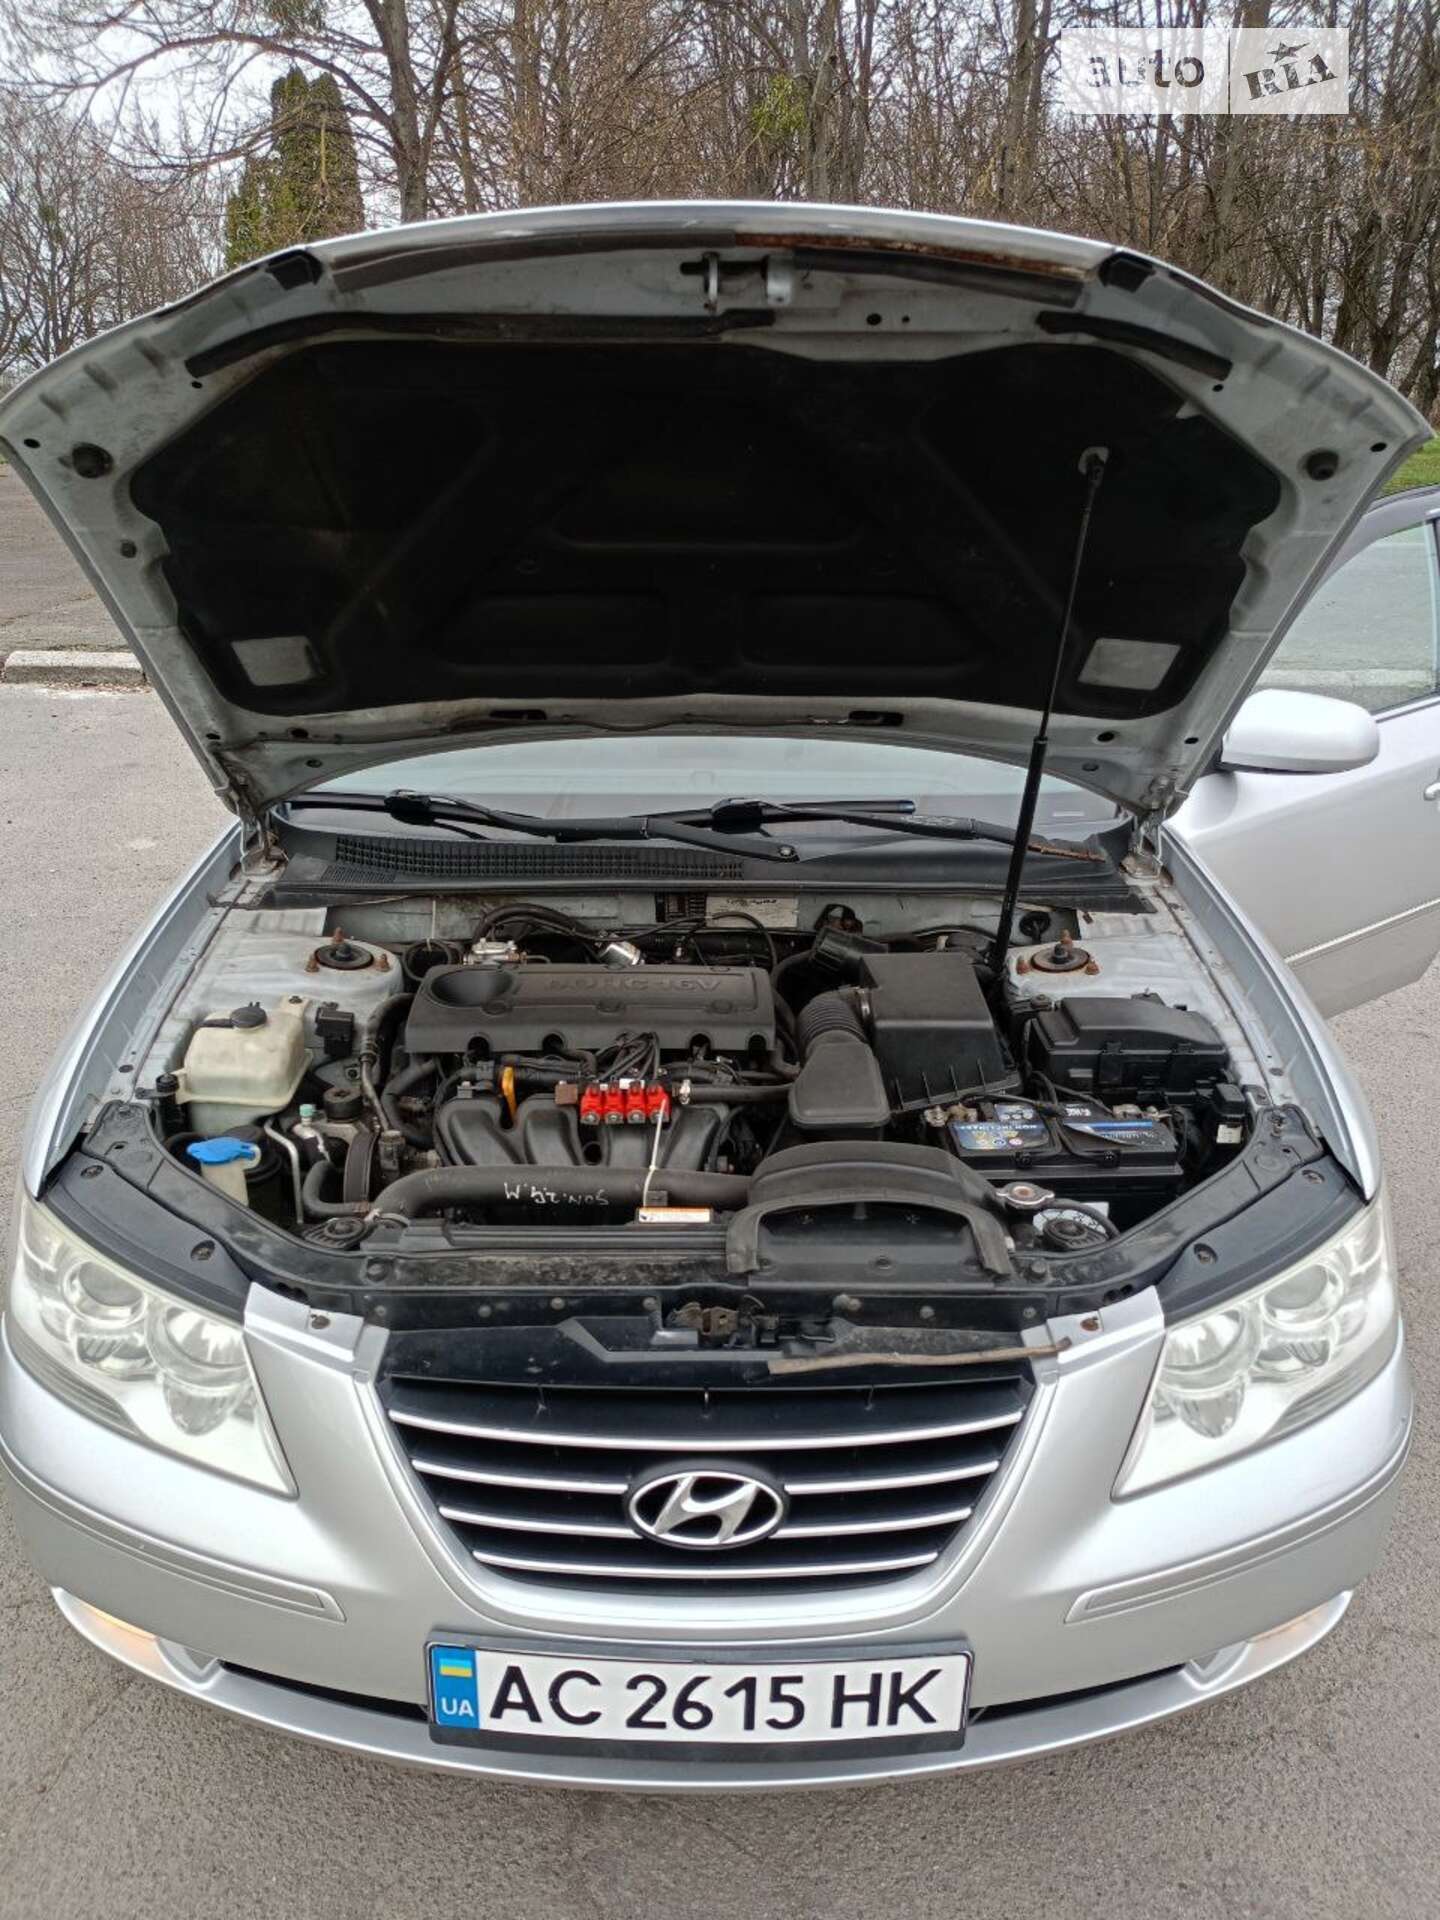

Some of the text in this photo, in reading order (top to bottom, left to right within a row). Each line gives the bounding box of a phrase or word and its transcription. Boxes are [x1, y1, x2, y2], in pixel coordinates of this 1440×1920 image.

[441, 1697, 475, 1717] UA
[489, 1665, 943, 1731] AC 2615 HK
